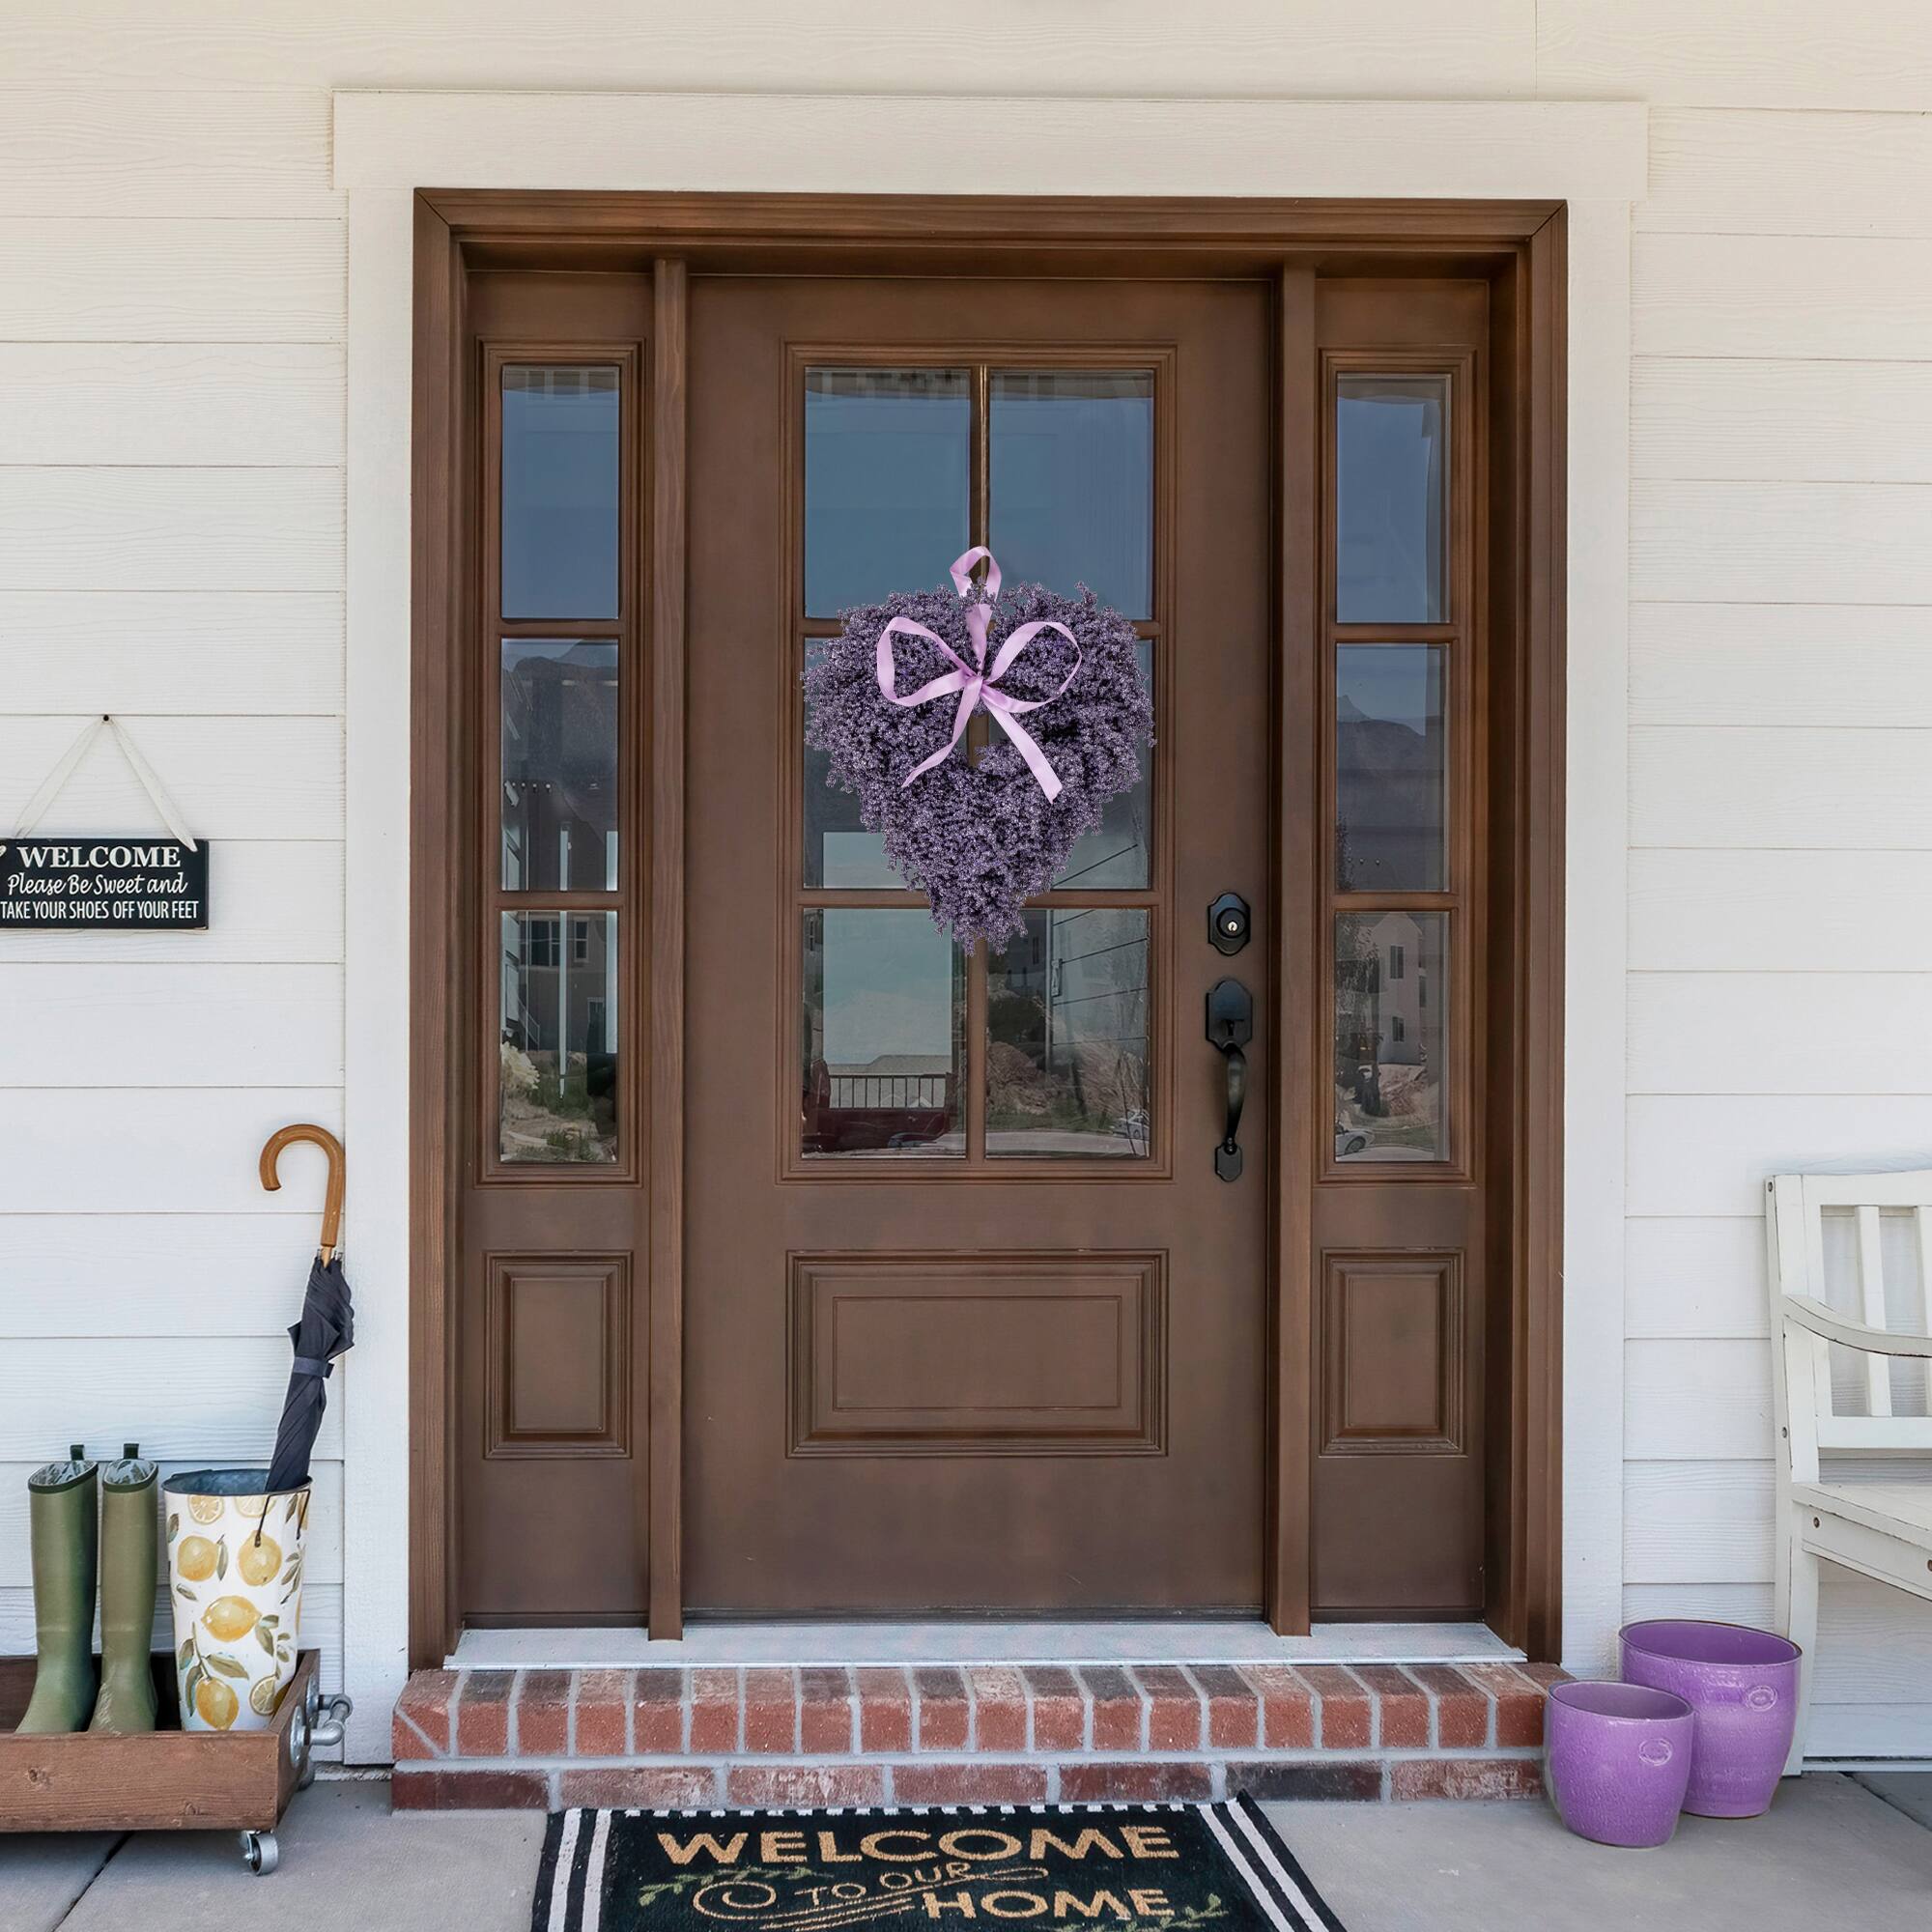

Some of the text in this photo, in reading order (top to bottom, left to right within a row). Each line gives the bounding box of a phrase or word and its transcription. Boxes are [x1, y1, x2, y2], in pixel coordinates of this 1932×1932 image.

[16, 846, 181, 867] WELCOME
[8, 872, 188, 895] Please Be Sweet and
[0, 900, 199, 919] TAKE YOUR SHOES OFF YOUR FEET
[657, 1826, 1179, 1864] WELCOME
[794, 1861, 971, 1906] TO OUR
[923, 1889, 1176, 1919] HOME
